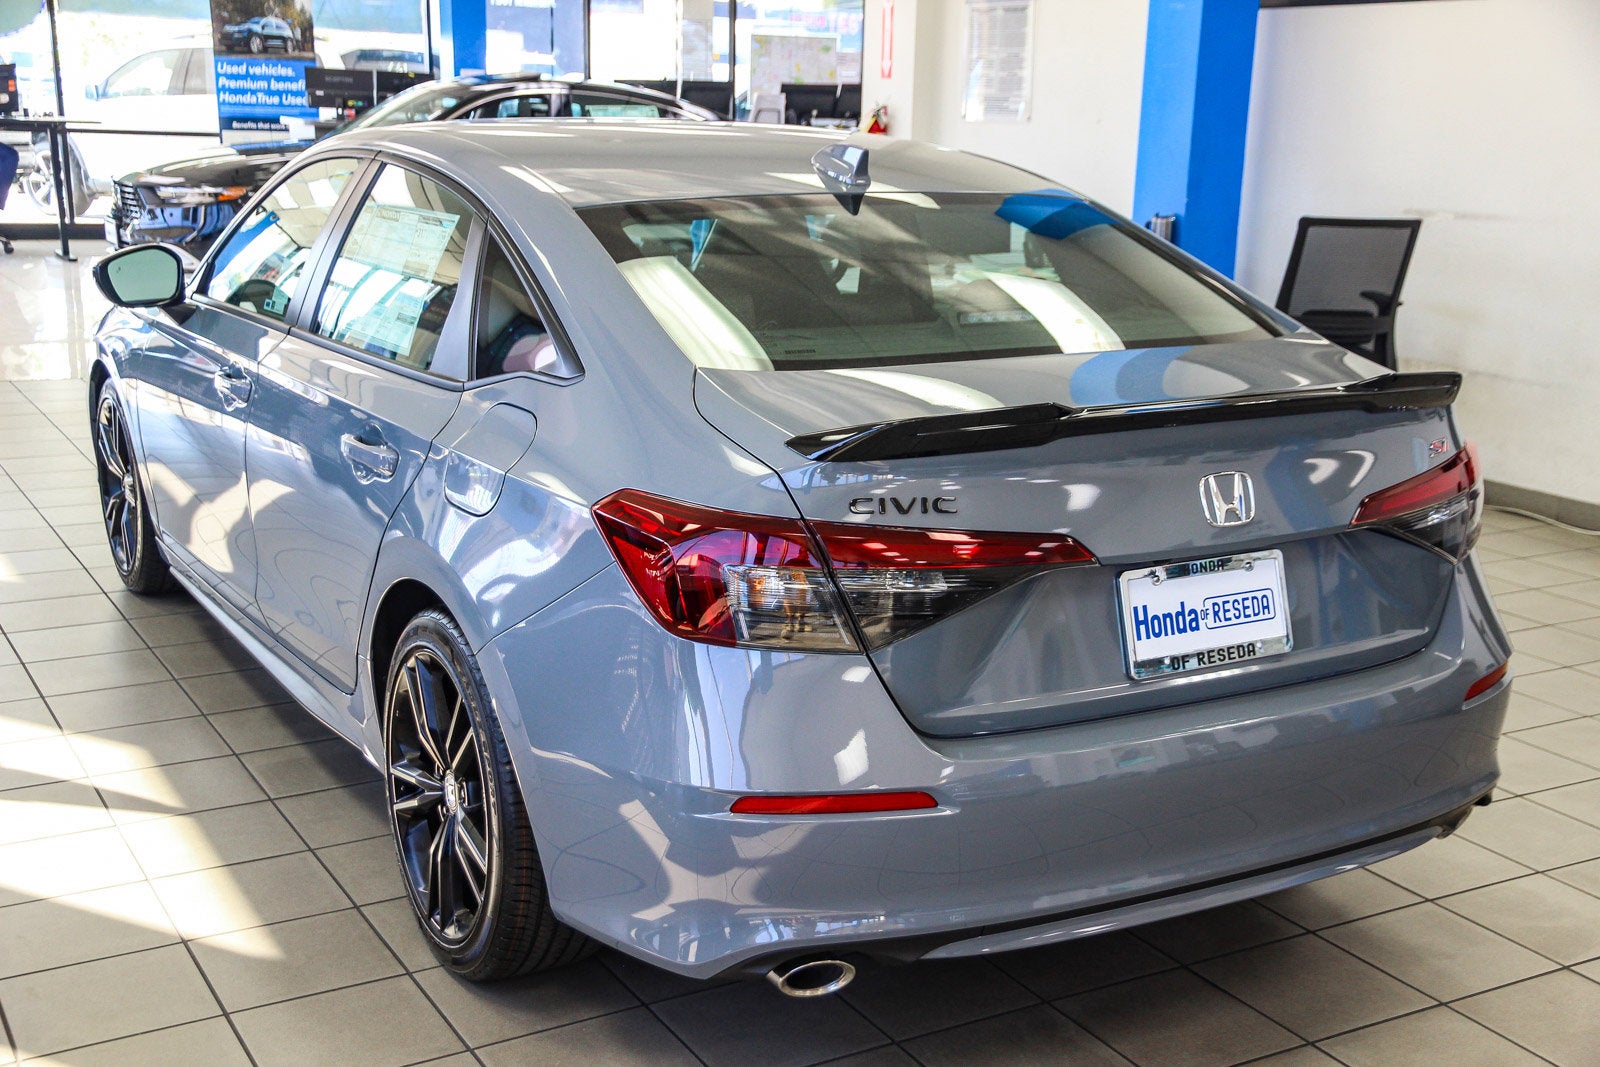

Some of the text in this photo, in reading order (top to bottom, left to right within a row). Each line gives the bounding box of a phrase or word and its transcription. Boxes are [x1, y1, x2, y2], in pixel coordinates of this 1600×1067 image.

[217, 62, 295, 77] Used vehicles.
[218, 76, 305, 91] Premium benefi
[220, 91, 279, 105] HondaTrue
[848, 497, 958, 515] CIVIC
[1186, 559, 1225, 576] ONDA
[1133, 594, 1271, 641] Honda OF RESEDA
[1171, 642, 1257, 671] OF RESEDA
